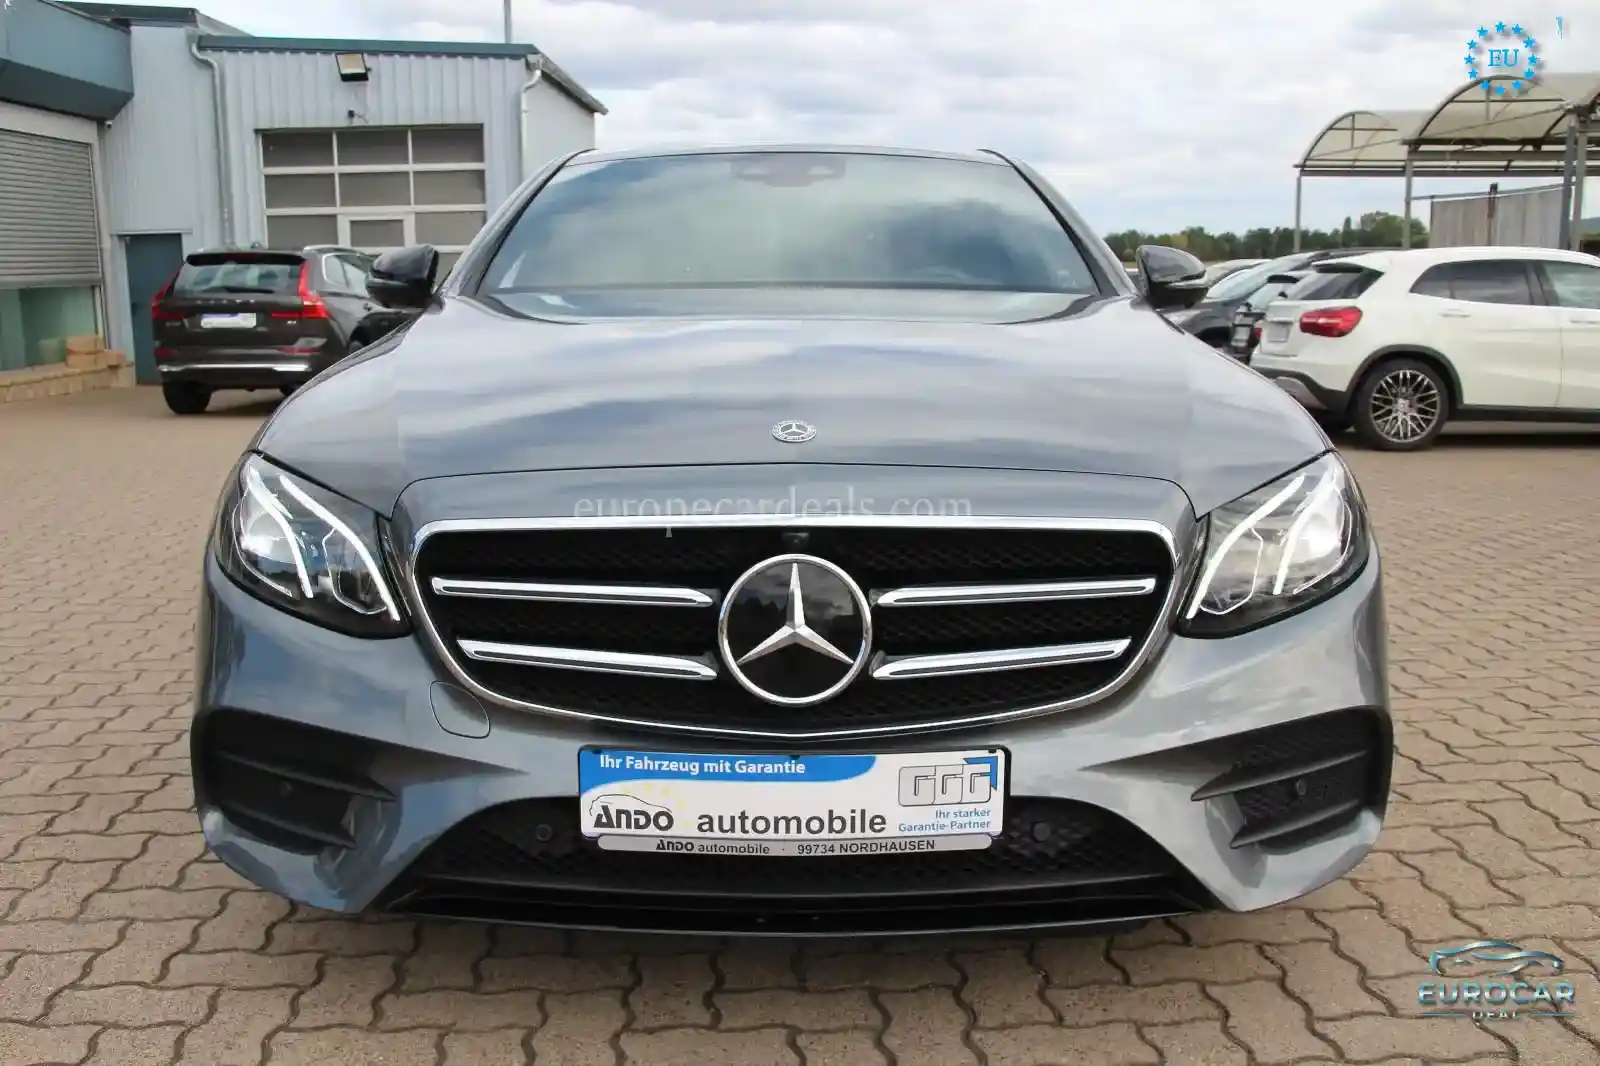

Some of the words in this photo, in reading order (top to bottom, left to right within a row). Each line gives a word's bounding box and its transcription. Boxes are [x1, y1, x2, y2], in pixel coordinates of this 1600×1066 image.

[600, 755, 622, 769] Ihr
[626, 756, 700, 775] Fahrzeug
[704, 759, 731, 773] mit
[735, 760, 806, 774] Garantie
[697, 809, 887, 835] automobile
[935, 809, 950, 819] Ihr
[952, 808, 991, 818] starker
[698, 843, 770, 854] automobile
[797, 843, 835, 855] 99734
[839, 839, 935, 854] NORDHAUSEN
